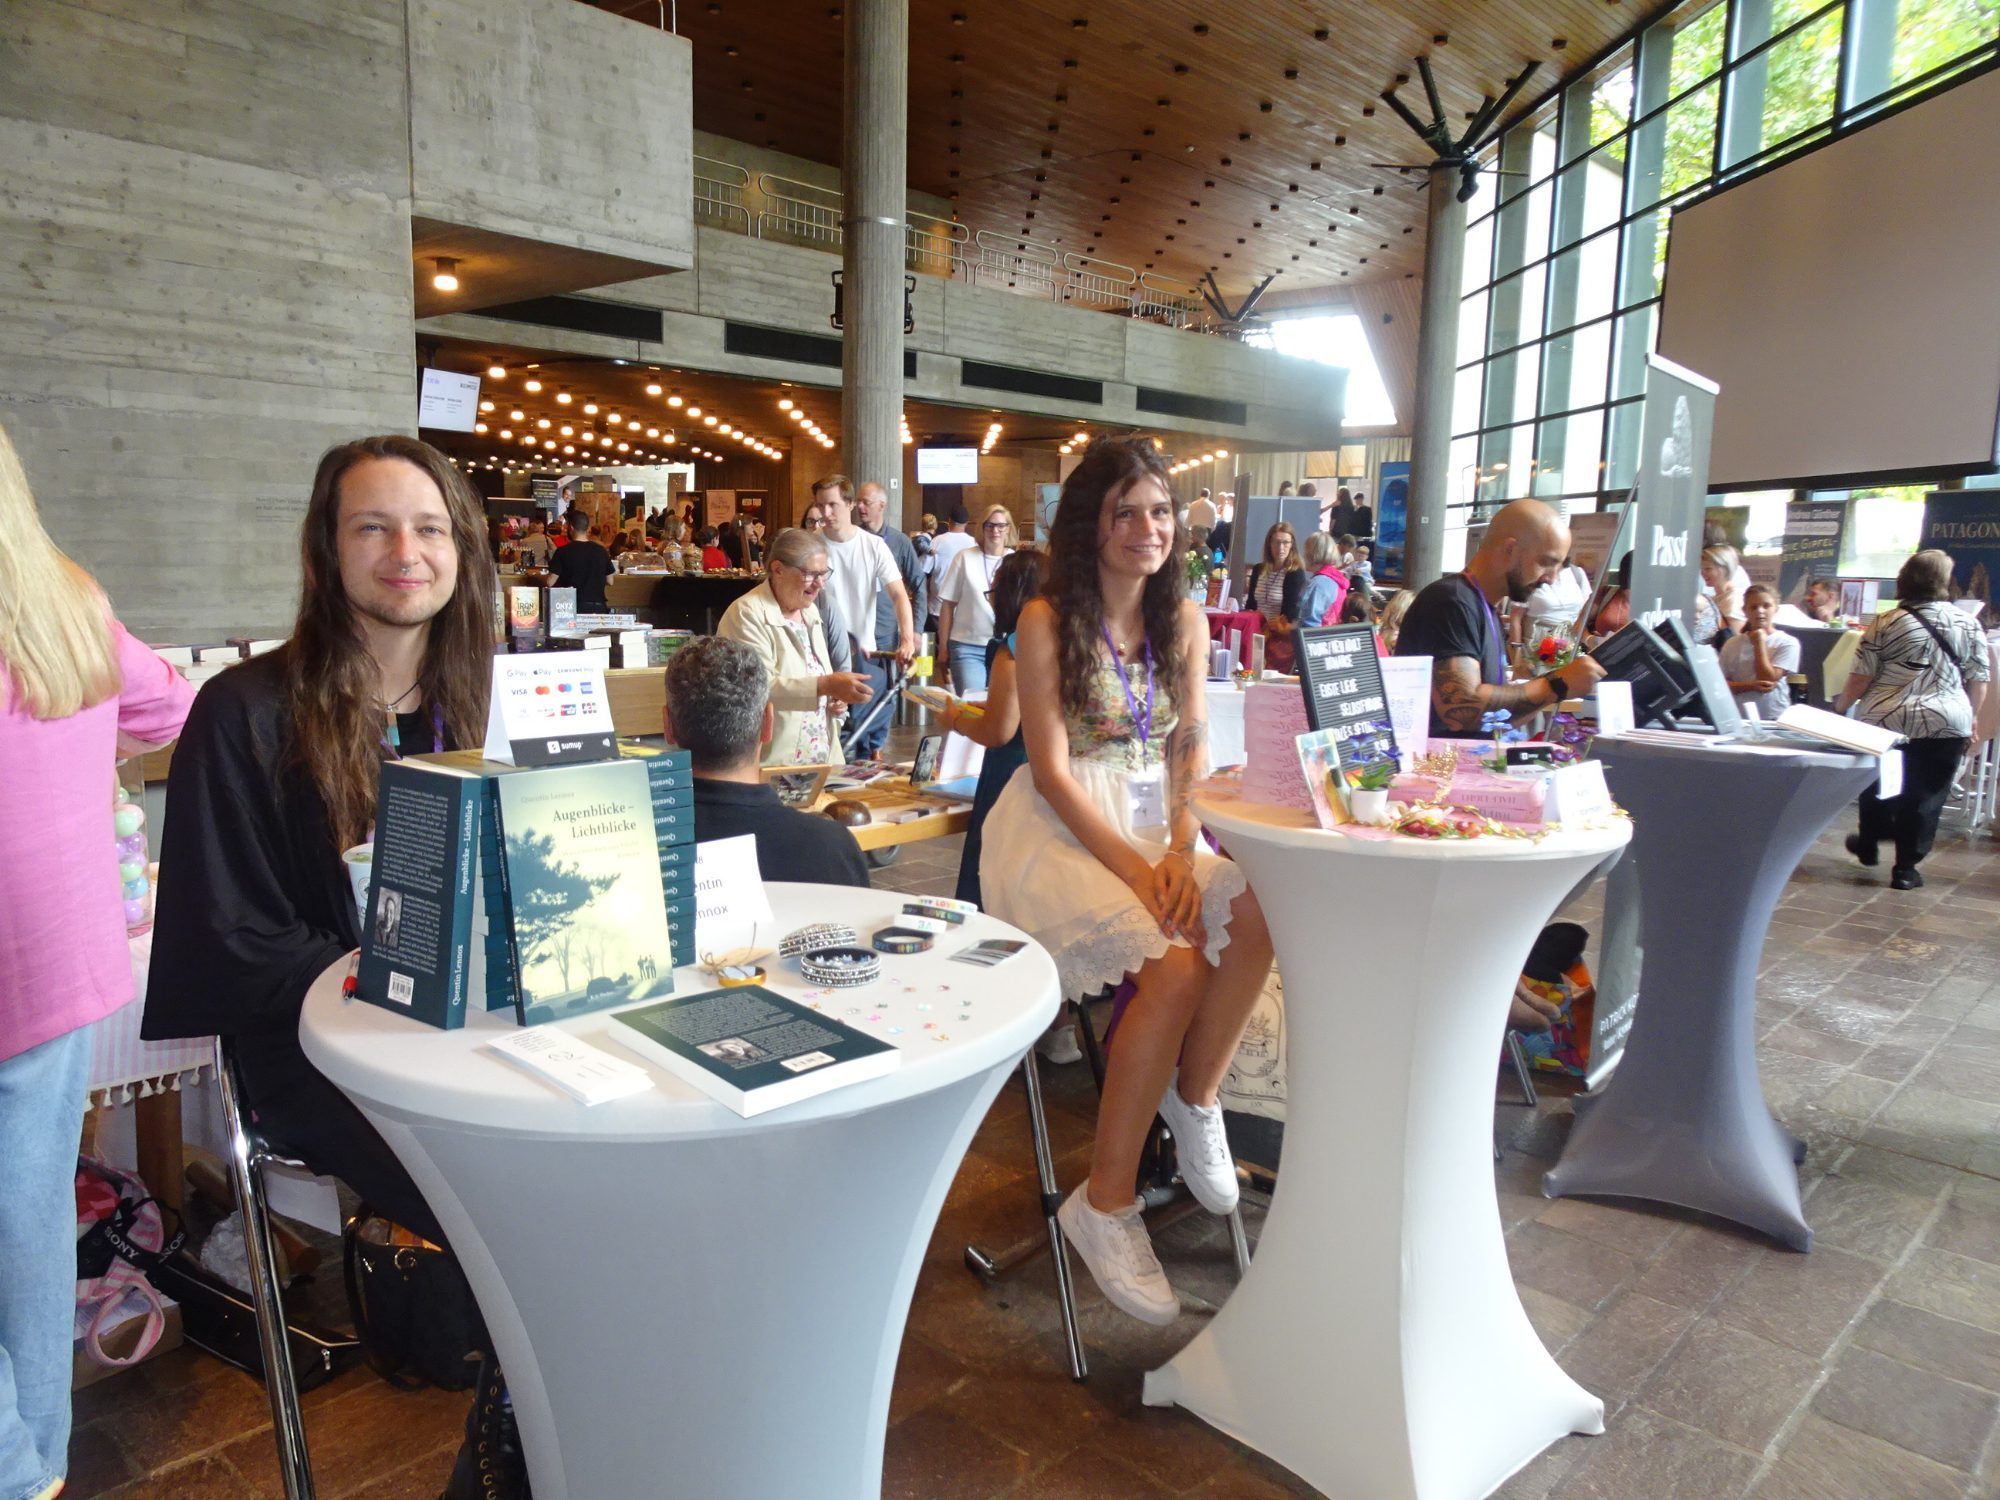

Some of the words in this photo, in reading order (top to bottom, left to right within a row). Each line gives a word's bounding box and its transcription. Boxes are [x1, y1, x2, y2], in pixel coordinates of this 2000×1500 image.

[1650, 525, 1688, 567] Passt
[517, 602, 534, 610] IRON
[555, 611, 574, 619] STORM
[648, 759, 673, 769] Quentin
[463, 799, 473, 841] Lichtblicke
[553, 802, 626, 823] Augenblicke
[571, 820, 637, 838] Lichtblicke
[460, 848, 470, 895] Augenblicke
[695, 878, 723, 891] ntin
[697, 905, 728, 919] nnox
[455, 944, 463, 973] Lennox
[452, 974, 462, 1006] Quentin
[104, 1226, 139, 1259] SONY
